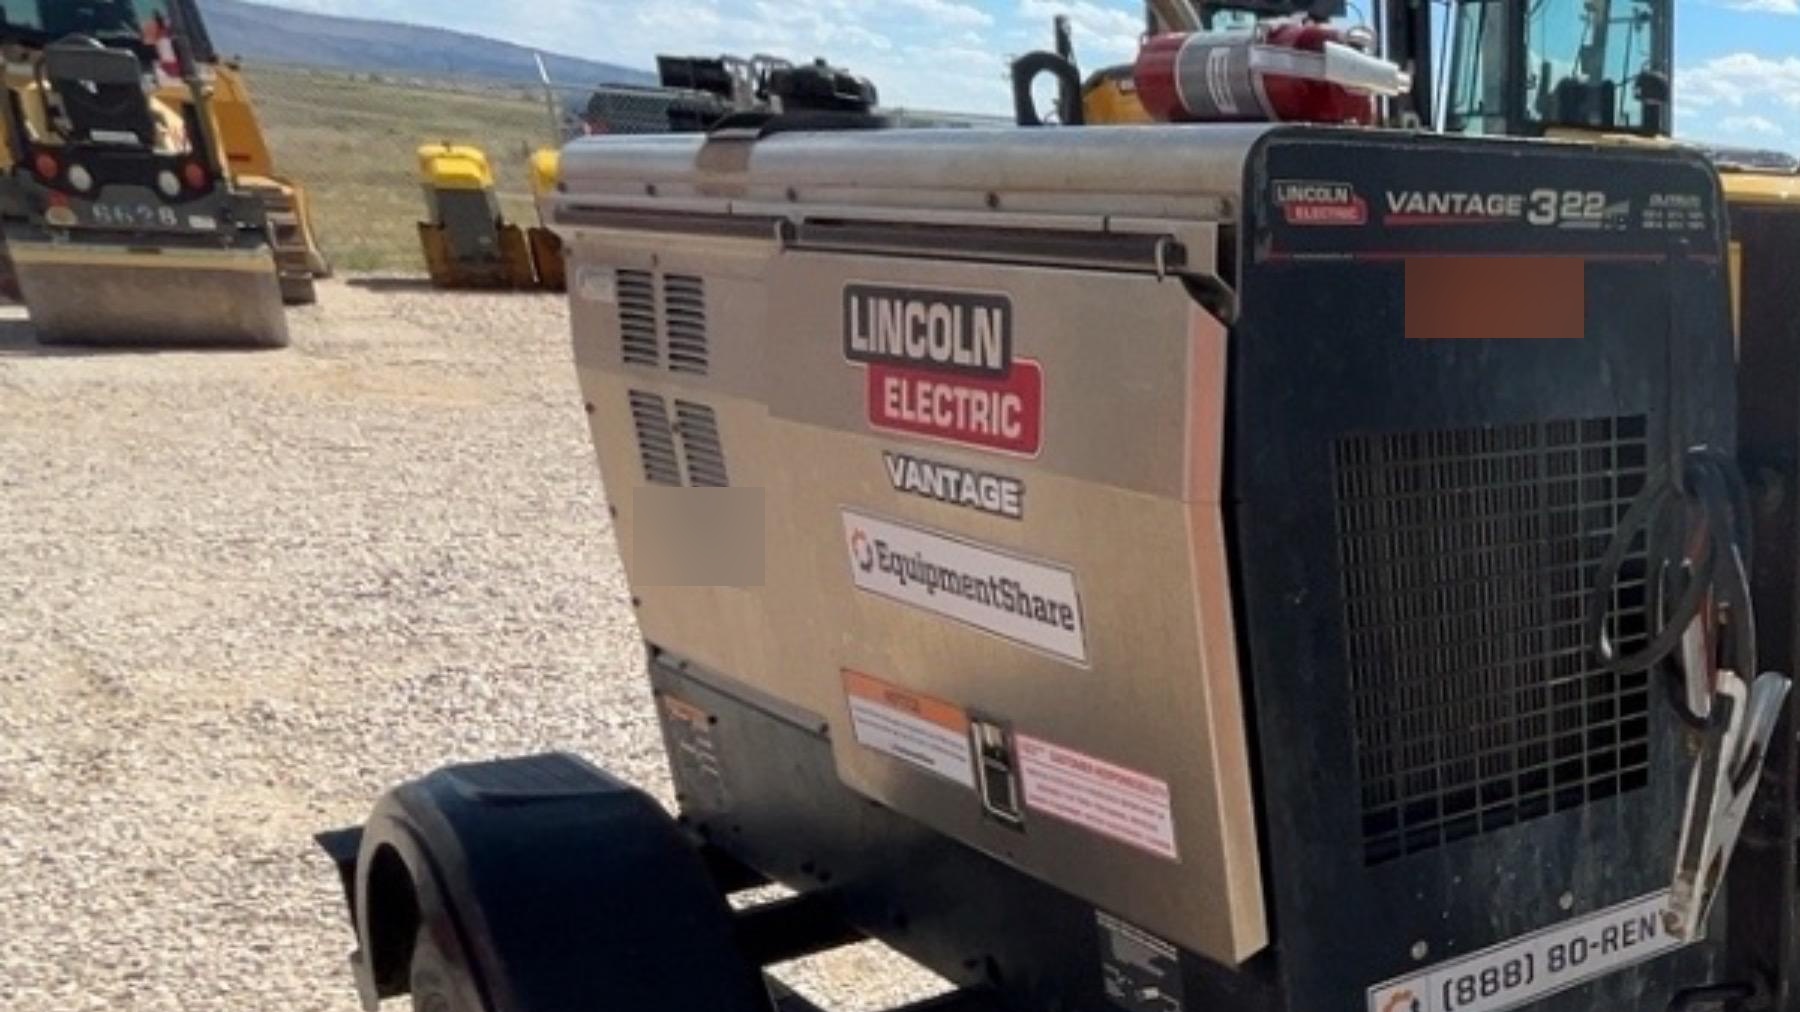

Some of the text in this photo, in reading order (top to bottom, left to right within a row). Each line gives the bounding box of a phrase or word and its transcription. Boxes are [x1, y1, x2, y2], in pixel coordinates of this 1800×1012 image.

[1276, 185, 1349, 203] LINCOLN
[1384, 190, 1523, 217] VANTAGE
[1527, 187, 1607, 226] 322
[850, 295, 1003, 370] LINCOLN
[883, 376, 1022, 439] ELECTRIC
[884, 451, 1023, 518] VANTAGE
[873, 538, 1075, 632] EquipmentShare
[1442, 907, 1665, 1012] (888) 80-REN
